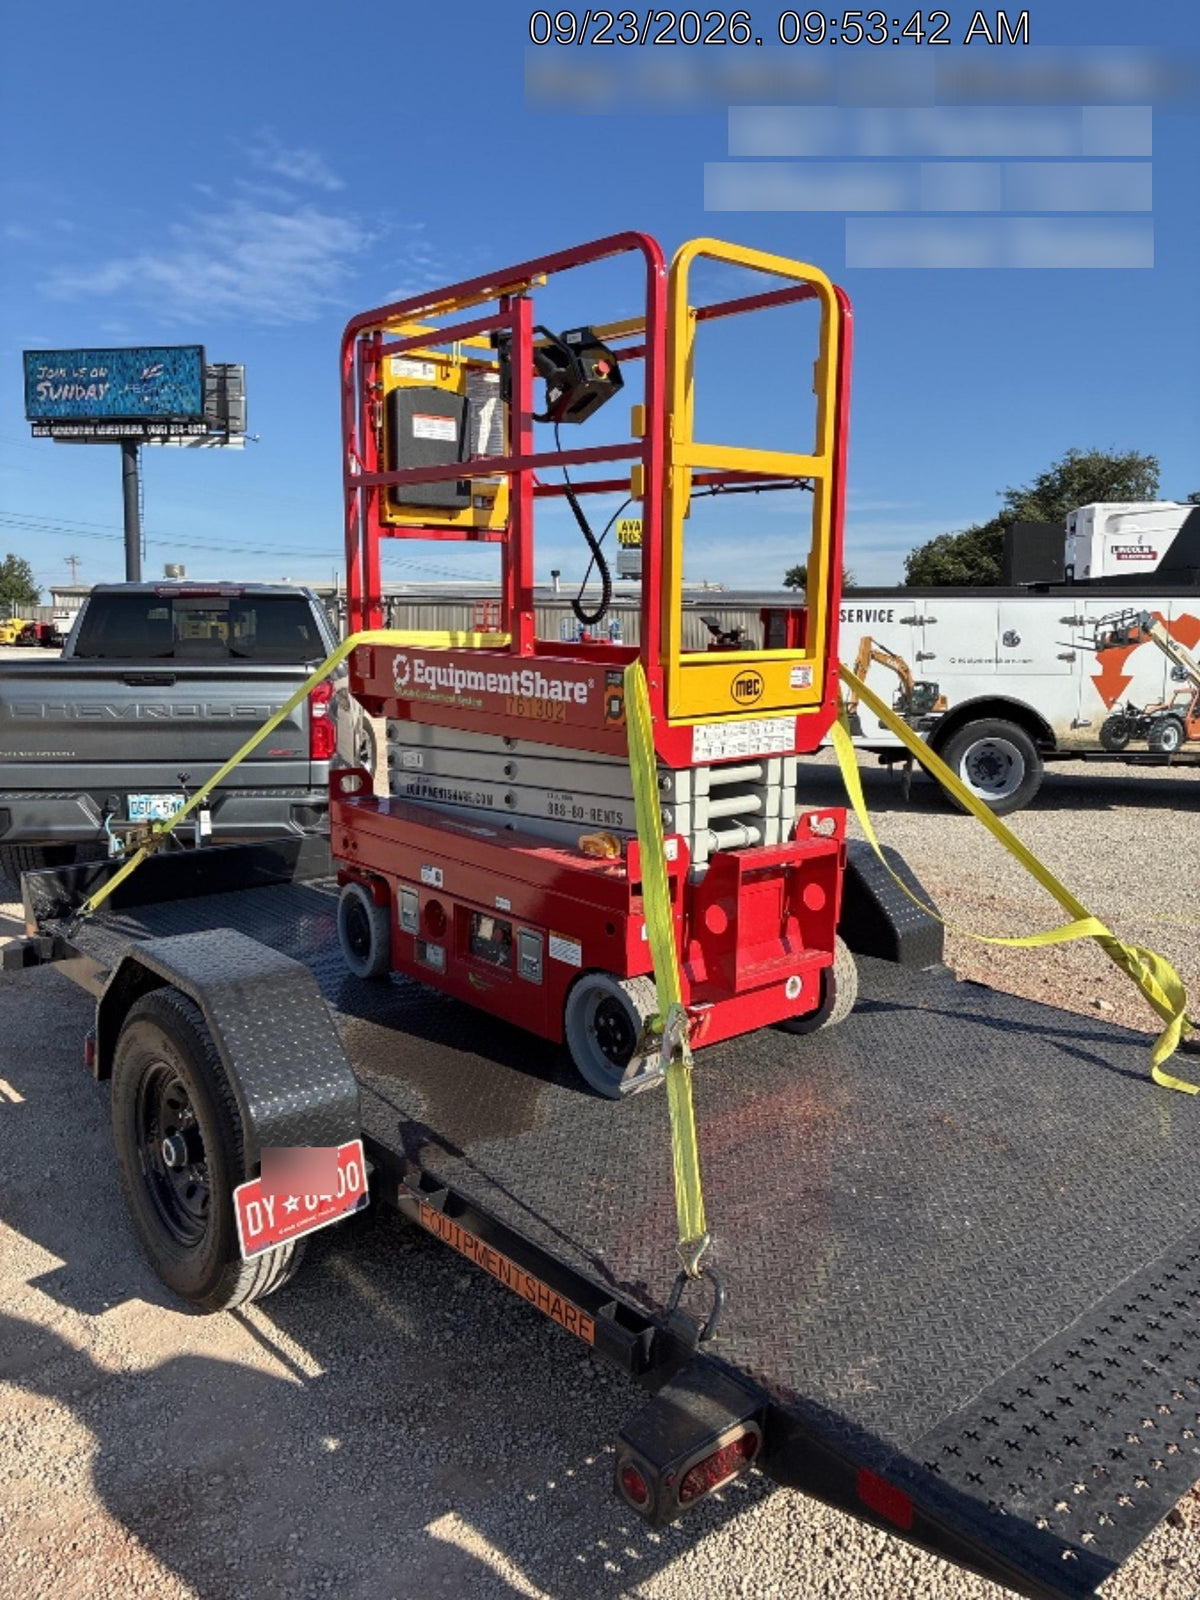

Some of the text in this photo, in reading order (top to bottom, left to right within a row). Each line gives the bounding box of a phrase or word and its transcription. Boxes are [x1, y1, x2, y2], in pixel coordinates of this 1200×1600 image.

[37, 367, 66, 379] JOIN
[90, 367, 108, 378] ON
[36, 381, 110, 401] SUNDAY
[839, 609, 894, 623] SERVICE
[413, 658, 589, 704] EquipmentShare
[245, 1195, 275, 1237] DY
[420, 1203, 593, 1342] EQUIPMENTSHARE
